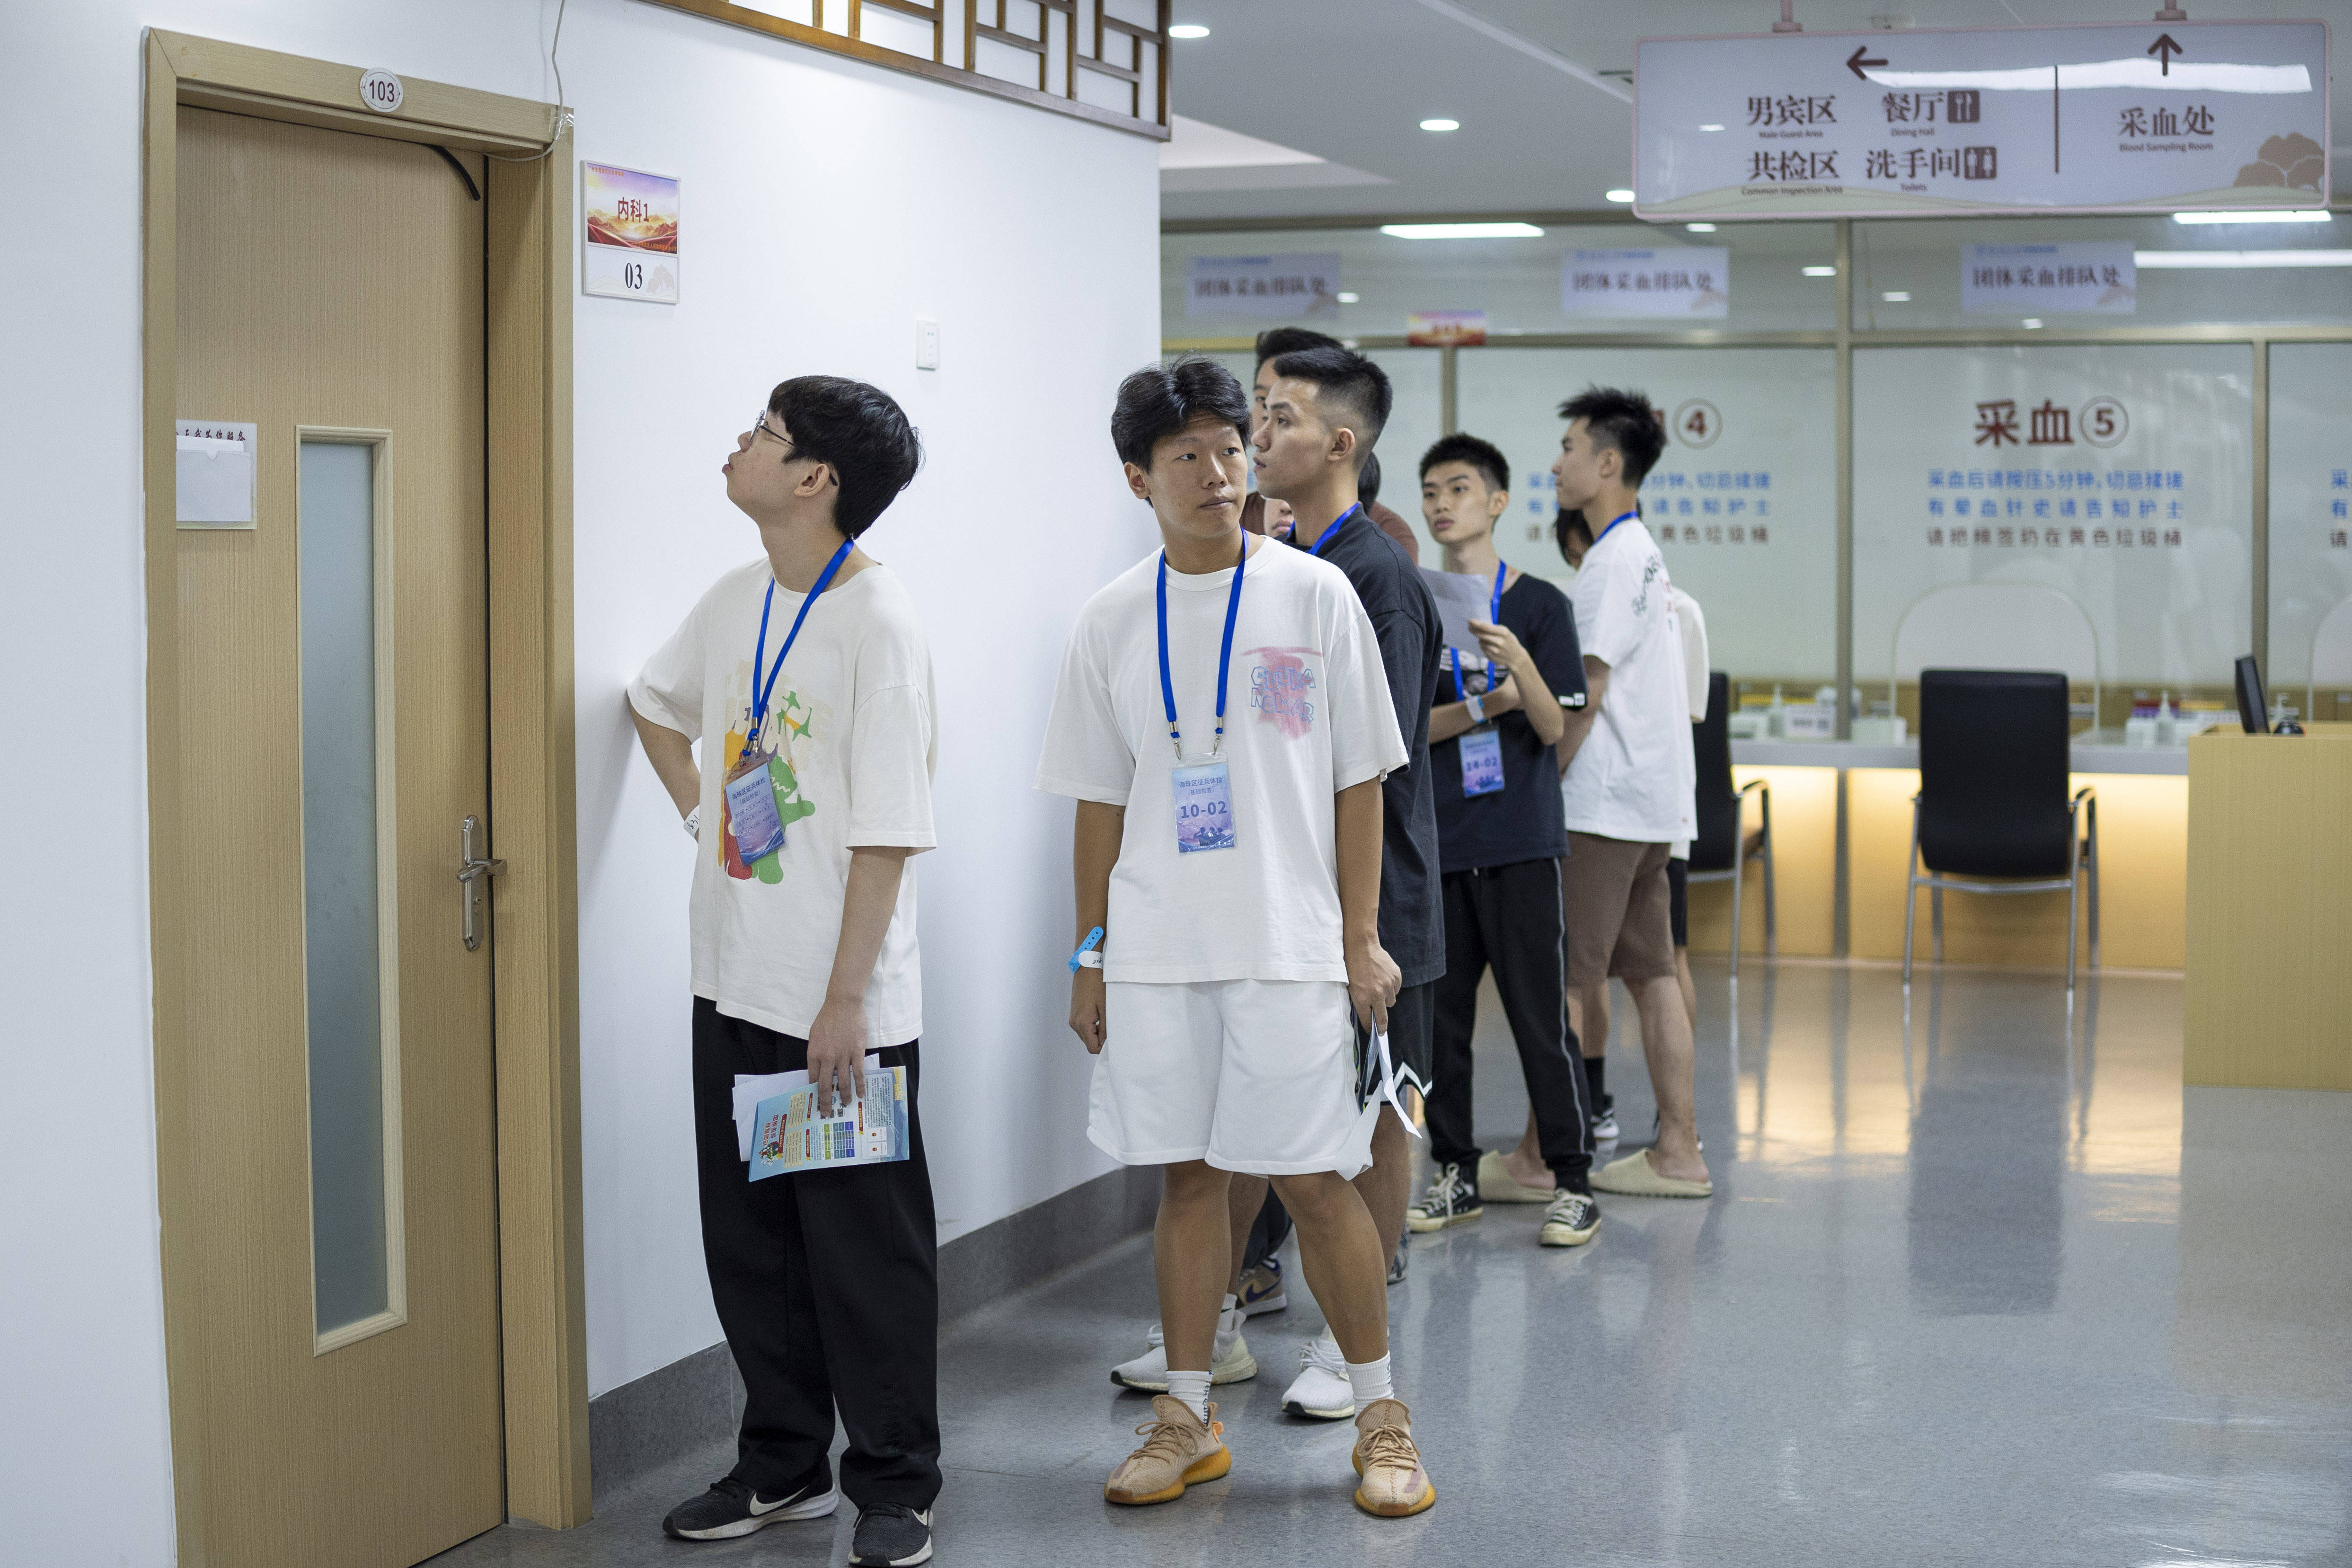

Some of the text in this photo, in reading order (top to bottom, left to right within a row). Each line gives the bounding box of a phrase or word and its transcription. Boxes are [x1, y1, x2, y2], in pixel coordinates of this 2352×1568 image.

[369, 79, 395, 102] 103
[1747, 95, 1837, 126] 男宾区
[1882, 92, 1943, 123] 餐厅
[1892, 126, 1935, 138] Dining Hall
[2117, 105, 2214, 138] 采血处
[1805, 130, 1823, 138] Area
[2120, 142, 2213, 153] Blood Sampling Room
[1748, 150, 1839, 181] 共检区
[1866, 148, 1960, 179] 洗手间
[1901, 183, 1927, 191] Toilets
[618, 197, 649, 223] 内科1
[625, 263, 643, 289] 03
[732, 777, 766, 801] 海珠区征兵体检
[1179, 777, 1223, 788] 海珠区征兵体检
[1180, 801, 1227, 818] 10-02
